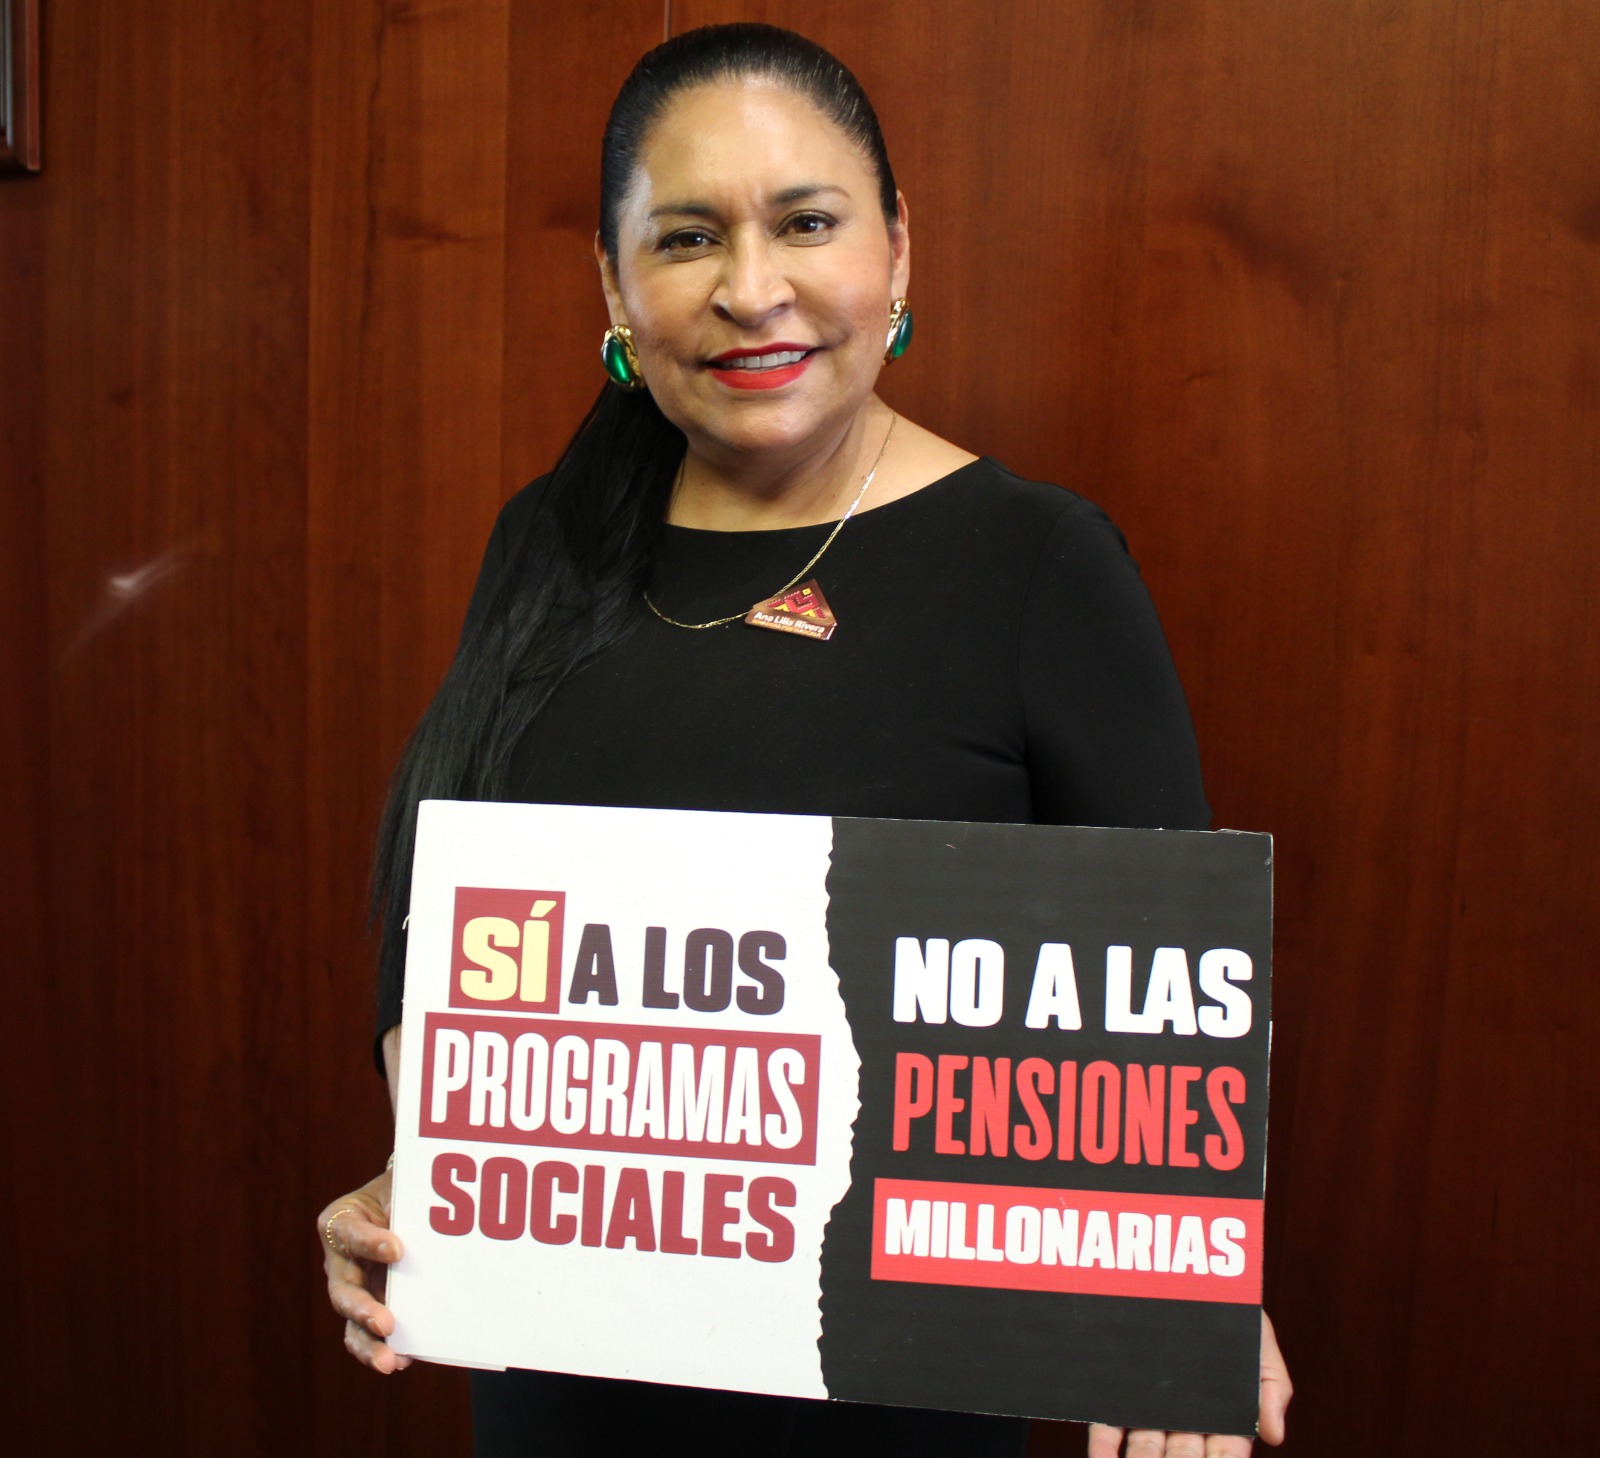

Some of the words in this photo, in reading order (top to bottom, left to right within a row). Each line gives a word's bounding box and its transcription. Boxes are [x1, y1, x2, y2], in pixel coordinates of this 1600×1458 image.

[753, 611, 774, 622] Ana
[794, 619, 825, 633] Rivera
[460, 899, 557, 1003] SÍ
[568, 923, 619, 1007] A
[642, 926, 787, 1015] LOS
[893, 937, 1005, 1028] NO
[1025, 942, 1082, 1031] A
[1105, 945, 1253, 1038] LAS
[431, 1028, 806, 1150] PROGRAMAS
[893, 1052, 1247, 1171] PENSIONES
[429, 1152, 797, 1264] SOCIALES
[884, 1198, 1247, 1278] MILLONARIAS
